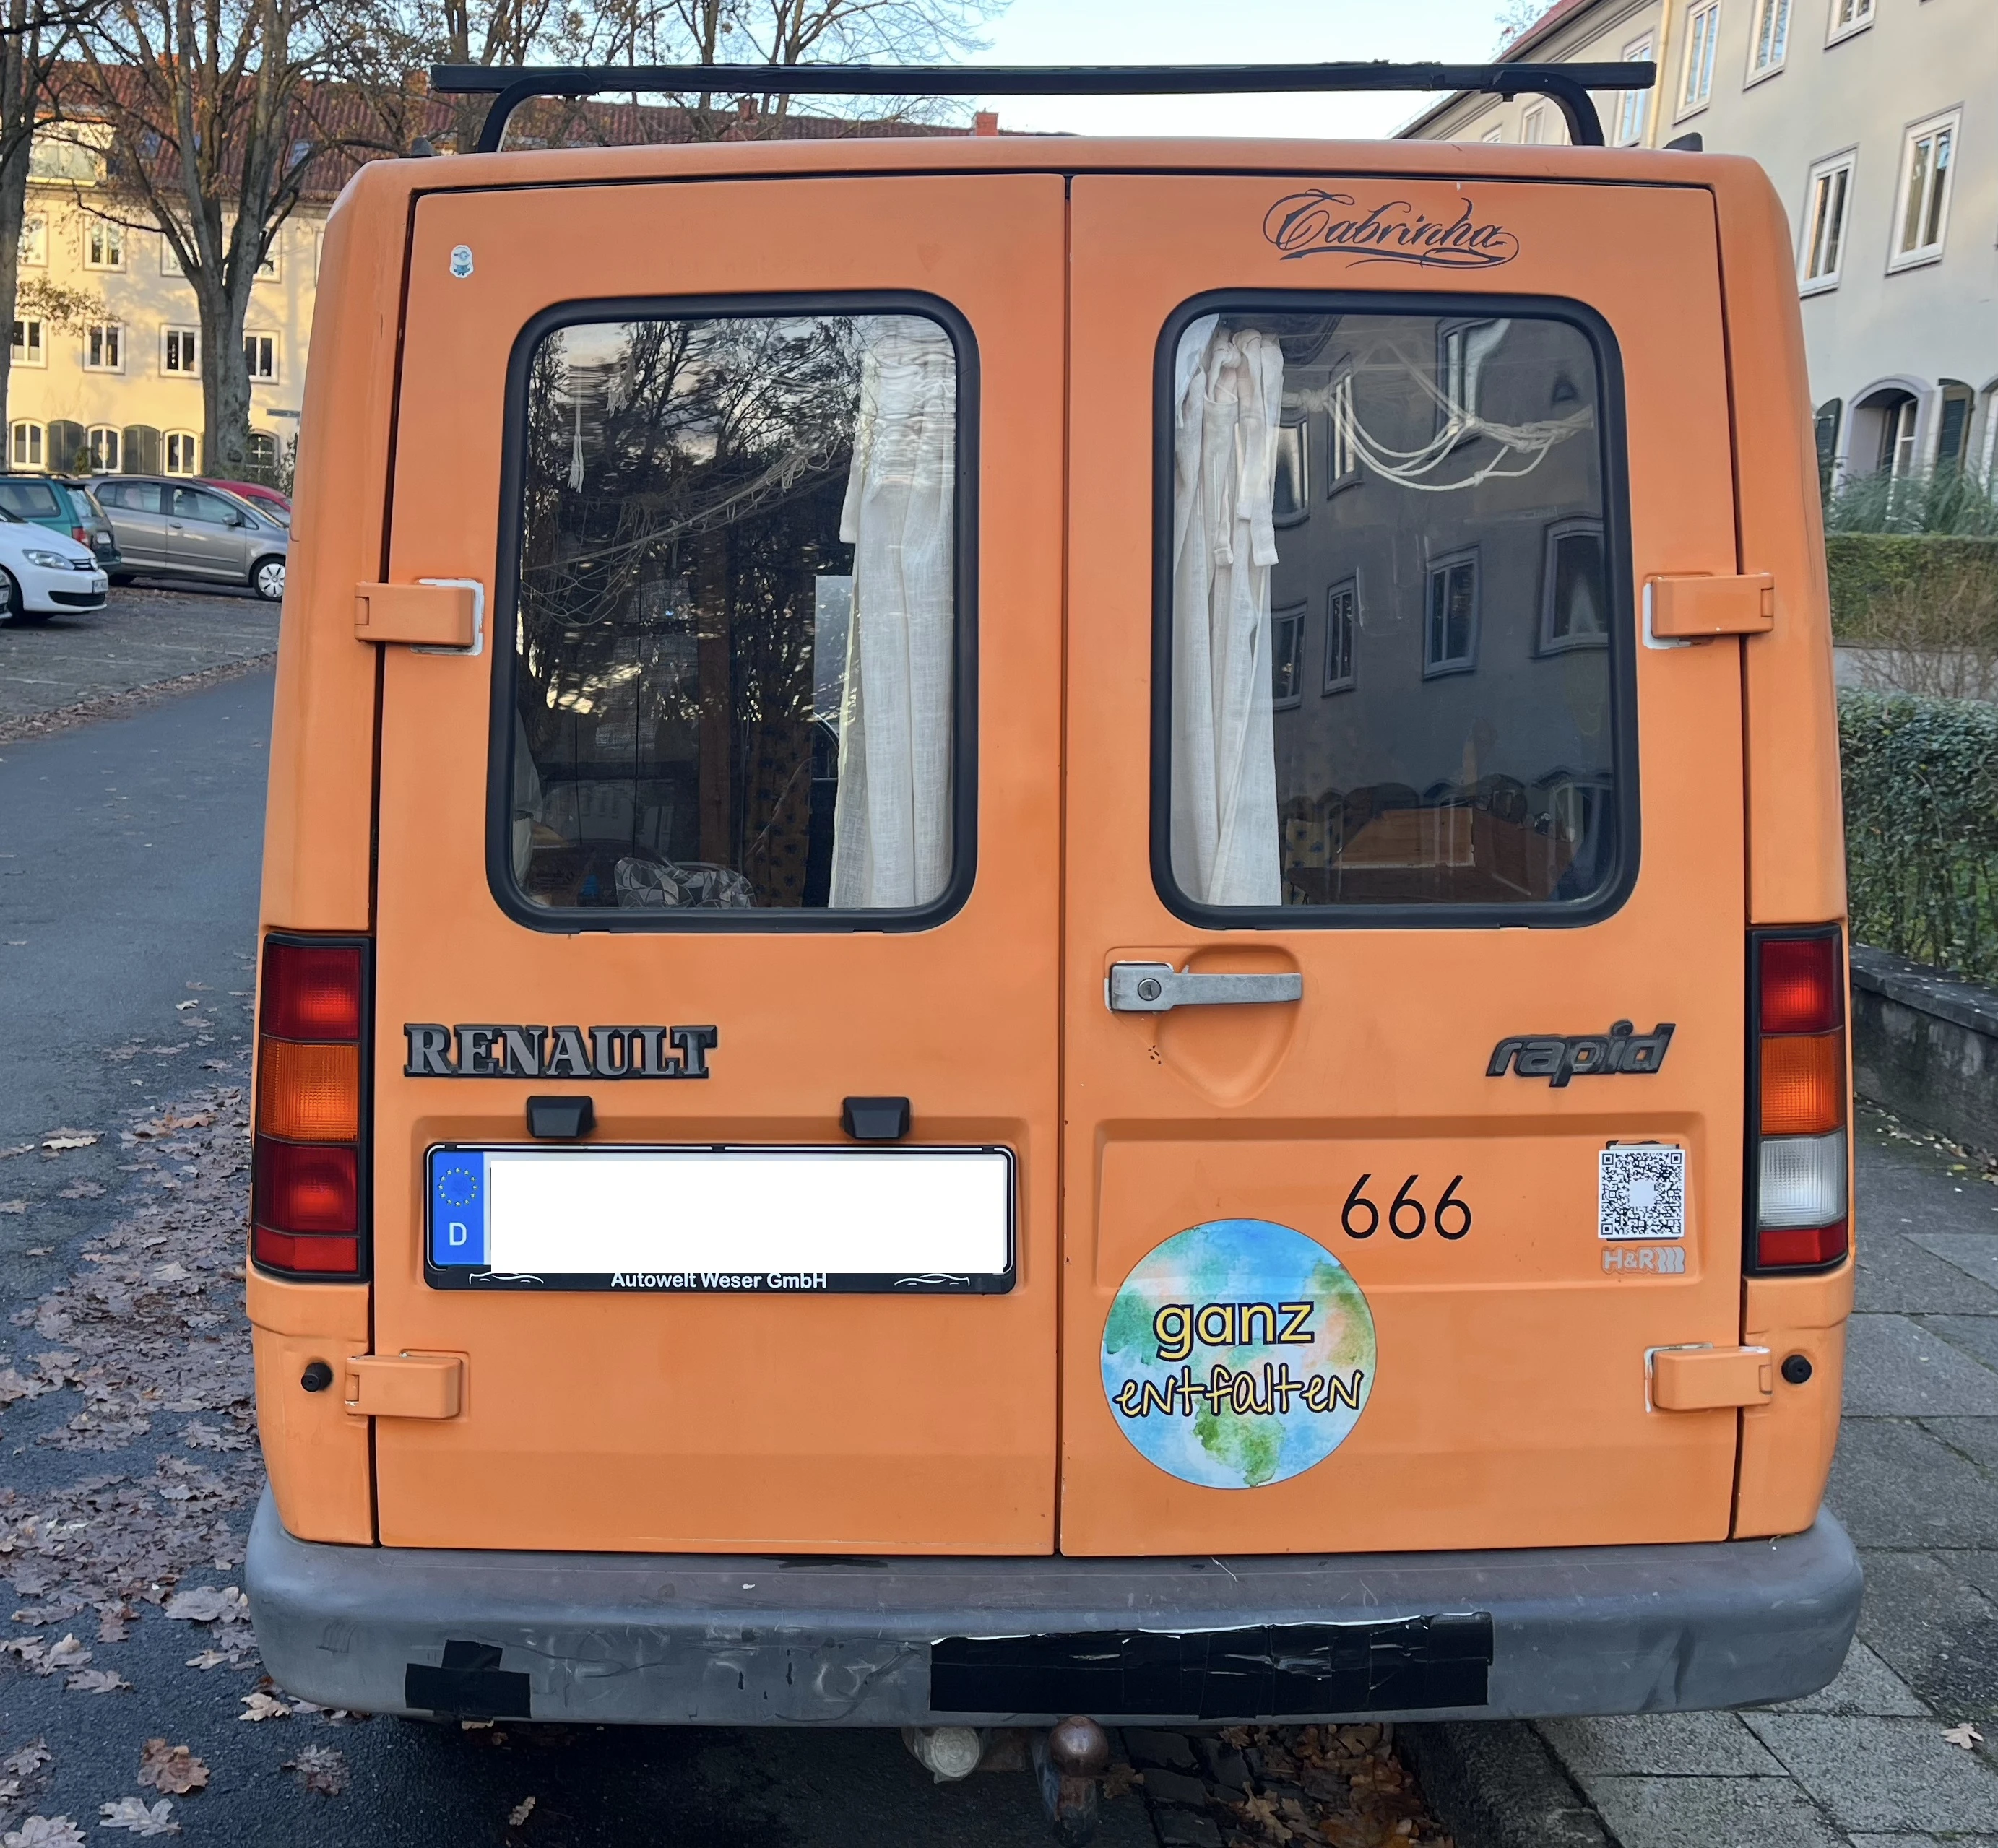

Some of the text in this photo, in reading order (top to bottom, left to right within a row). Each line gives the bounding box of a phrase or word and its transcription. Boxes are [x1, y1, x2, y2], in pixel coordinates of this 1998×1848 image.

[404, 1023, 717, 1079] RENAULT
[1486, 1020, 1676, 1087] rapid
[449, 1222, 467, 1246] D
[1341, 1174, 1471, 1239] 666
[611, 1272, 827, 1289] Autowelt Weser GmbH
[1603, 1248, 1657, 1272] H&R
[1153, 1301, 1315, 1361] ganz
